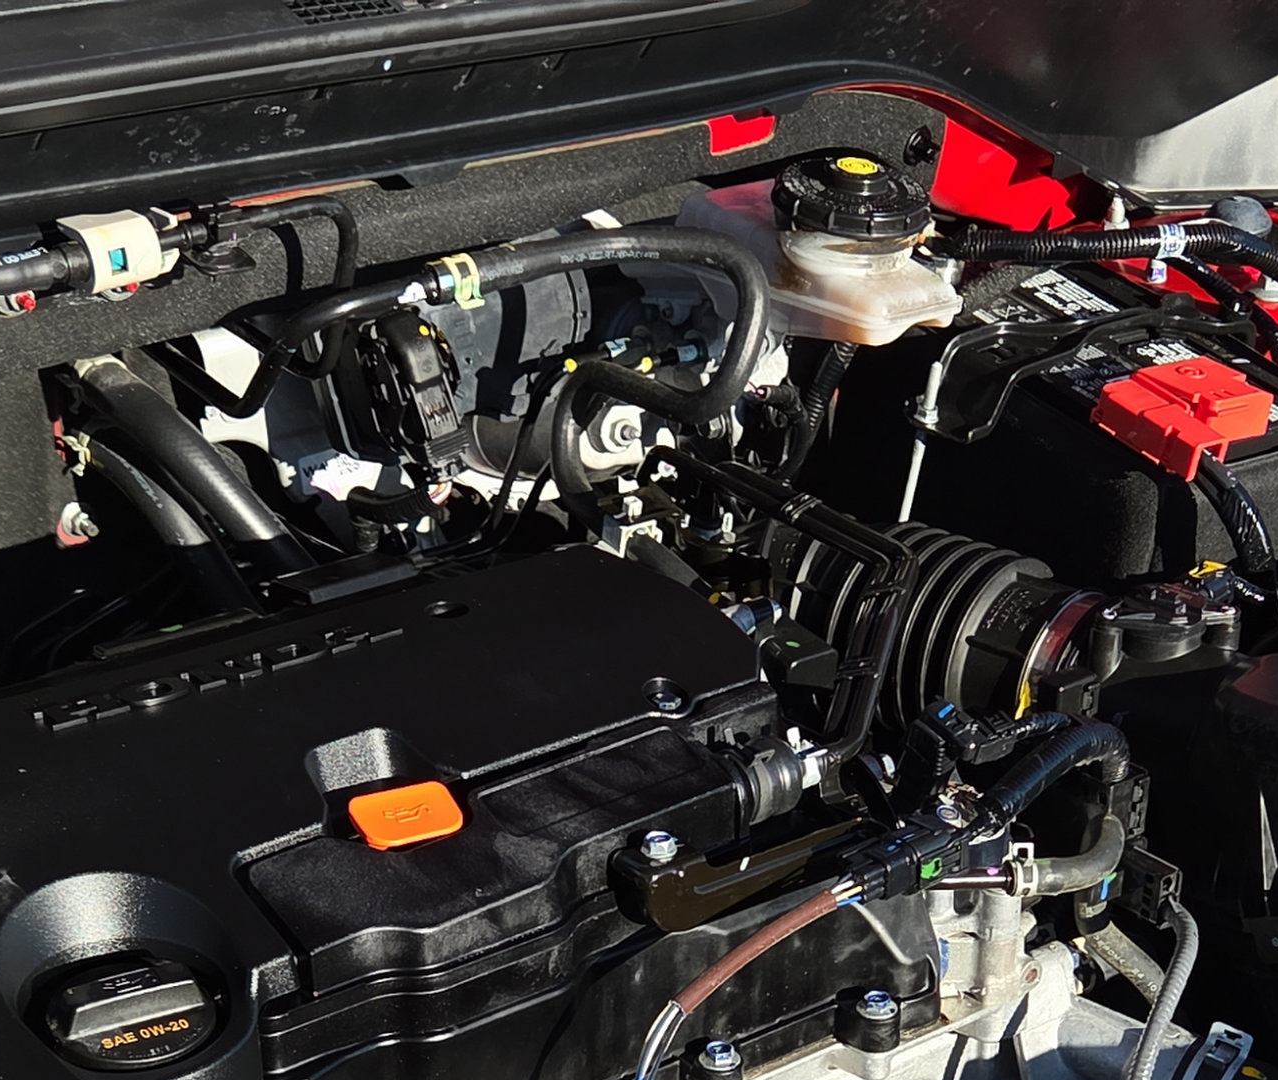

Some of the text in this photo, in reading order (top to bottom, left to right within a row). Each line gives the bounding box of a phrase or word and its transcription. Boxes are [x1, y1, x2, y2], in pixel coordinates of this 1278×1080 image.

[30, 625, 404, 732] HONDA
[101, 1018, 190, 1049] SAE 0W-20
